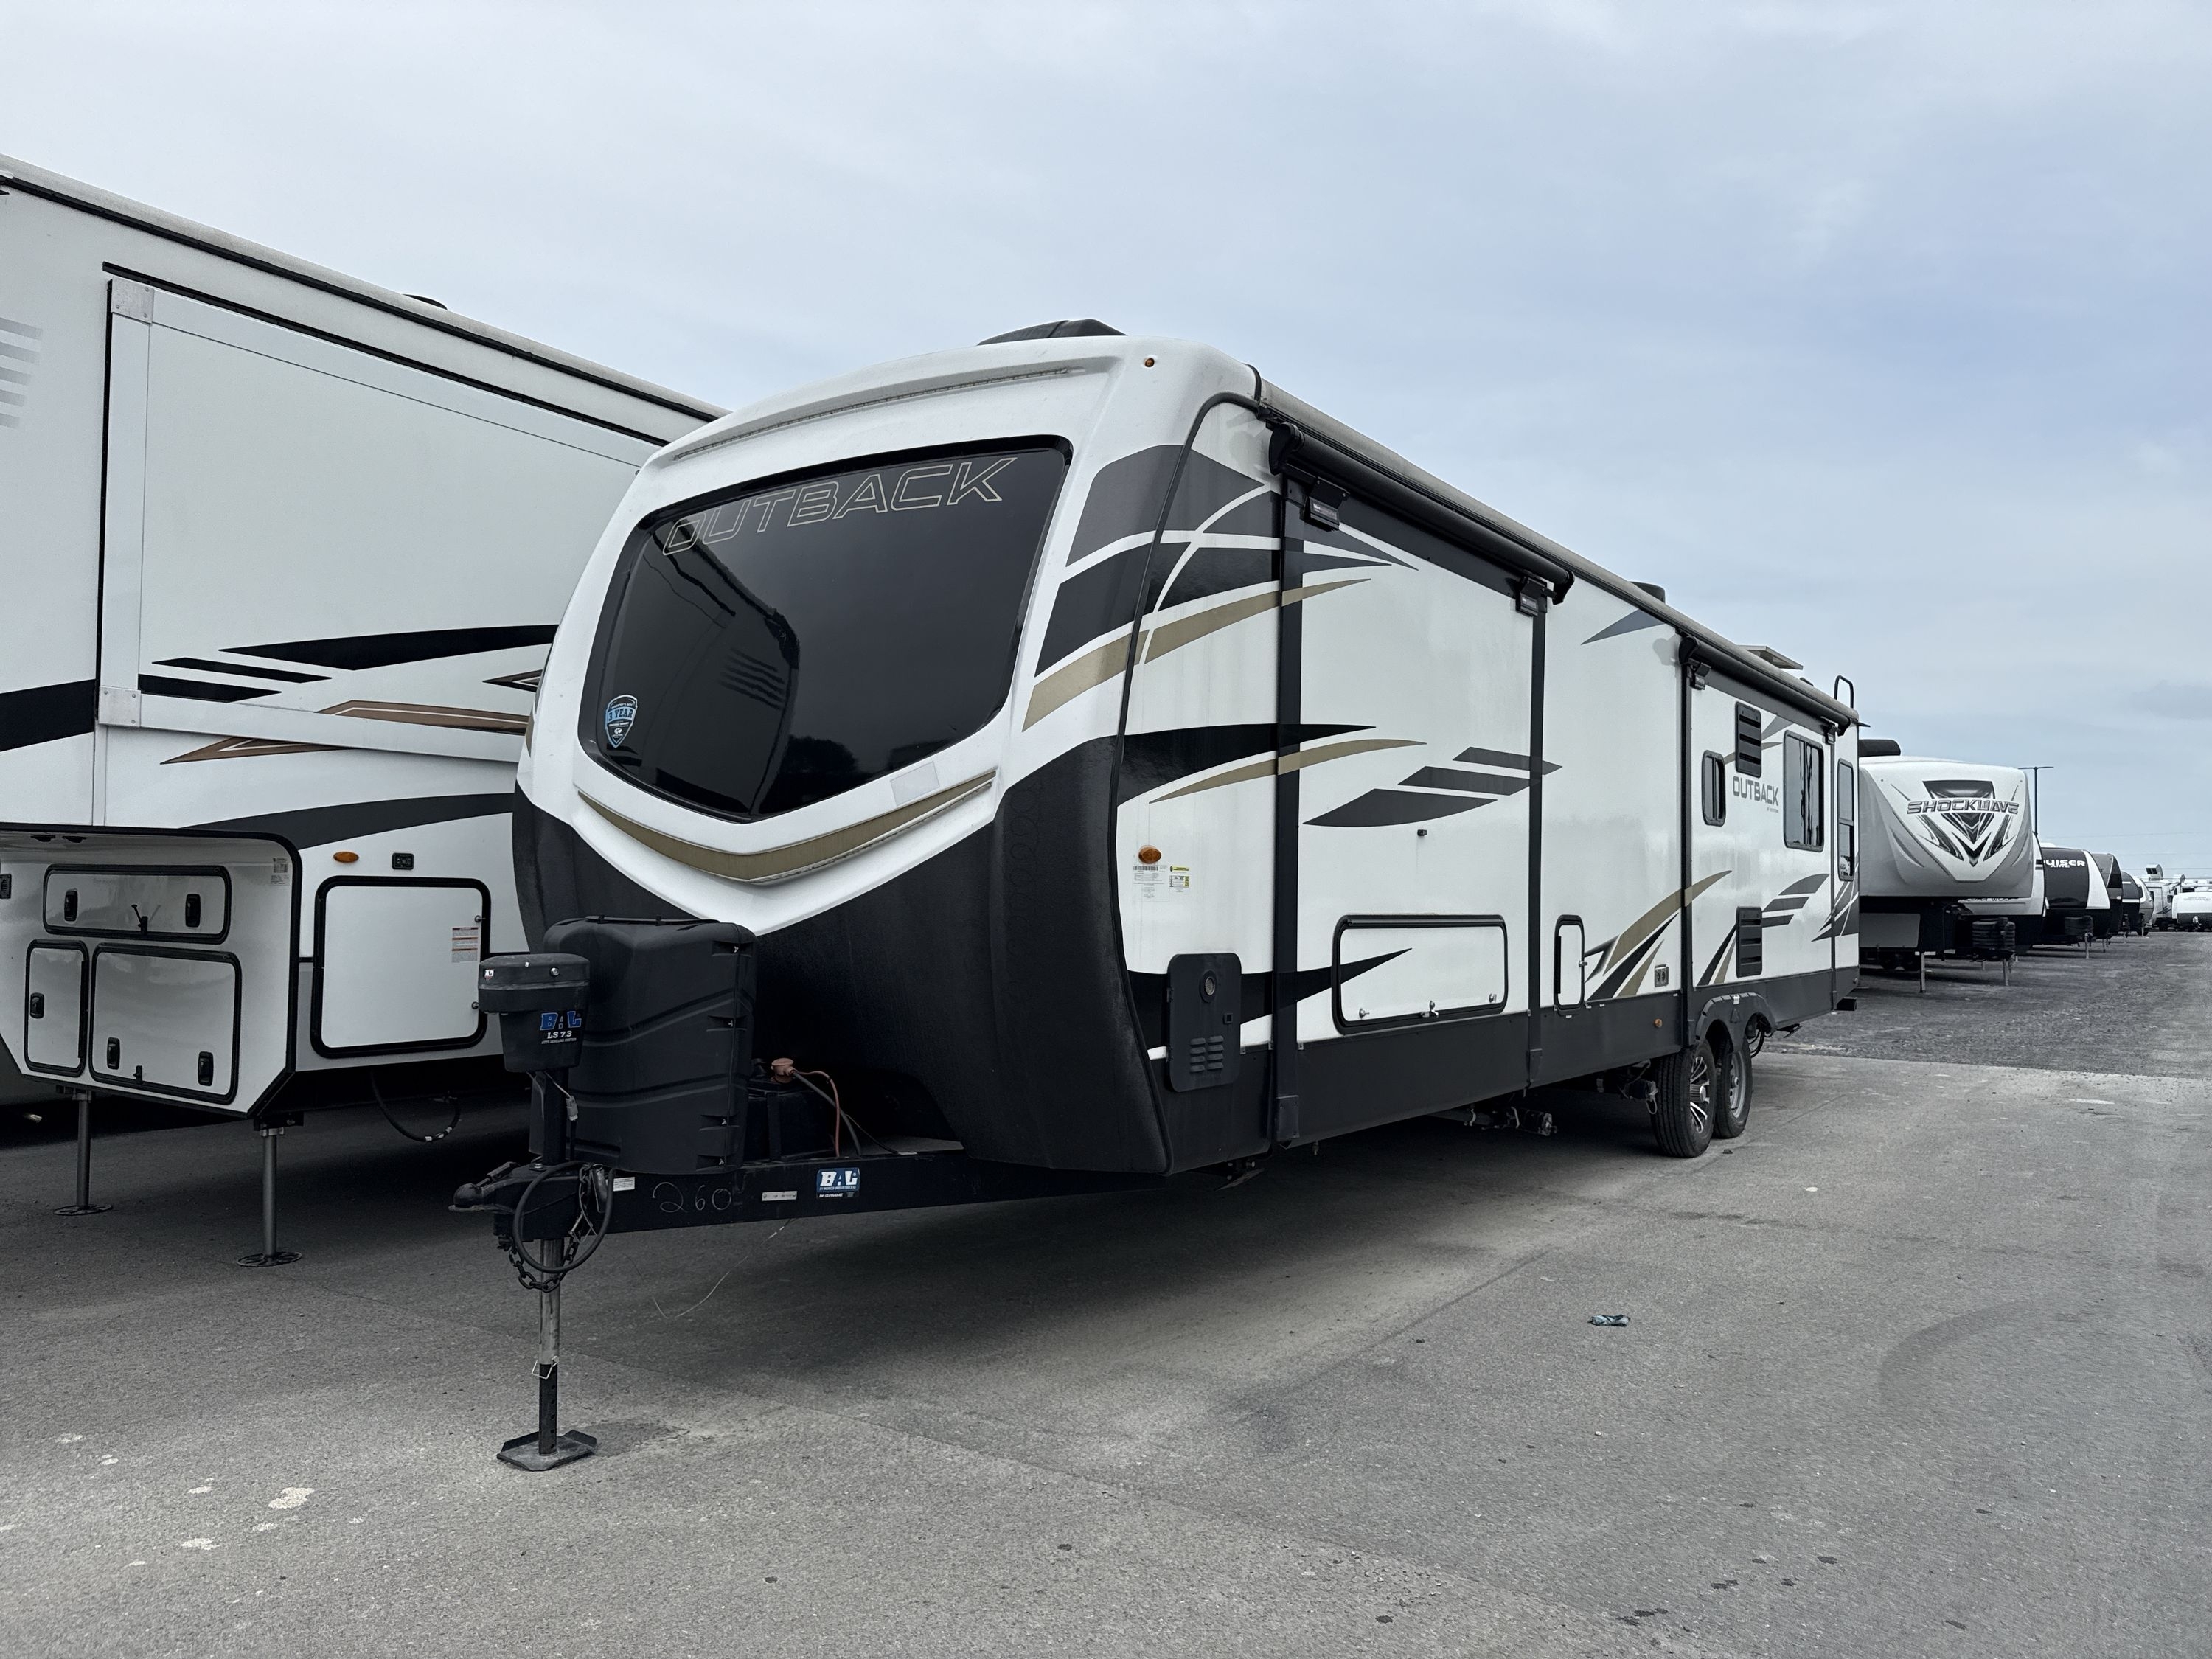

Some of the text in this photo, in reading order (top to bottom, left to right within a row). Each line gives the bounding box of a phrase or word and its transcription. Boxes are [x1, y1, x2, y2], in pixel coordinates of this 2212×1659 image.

[663, 457, 1018, 556] OUTBACK
[608, 709, 634, 722] 3 YEAR
[1733, 776, 1779, 807] OUTBACK
[1907, 799, 2020, 815] SHOCKWAVE
[2043, 859, 2086, 867] UISER
[540, 1011, 582, 1031] BAL
[819, 1170, 858, 1187] BAL
